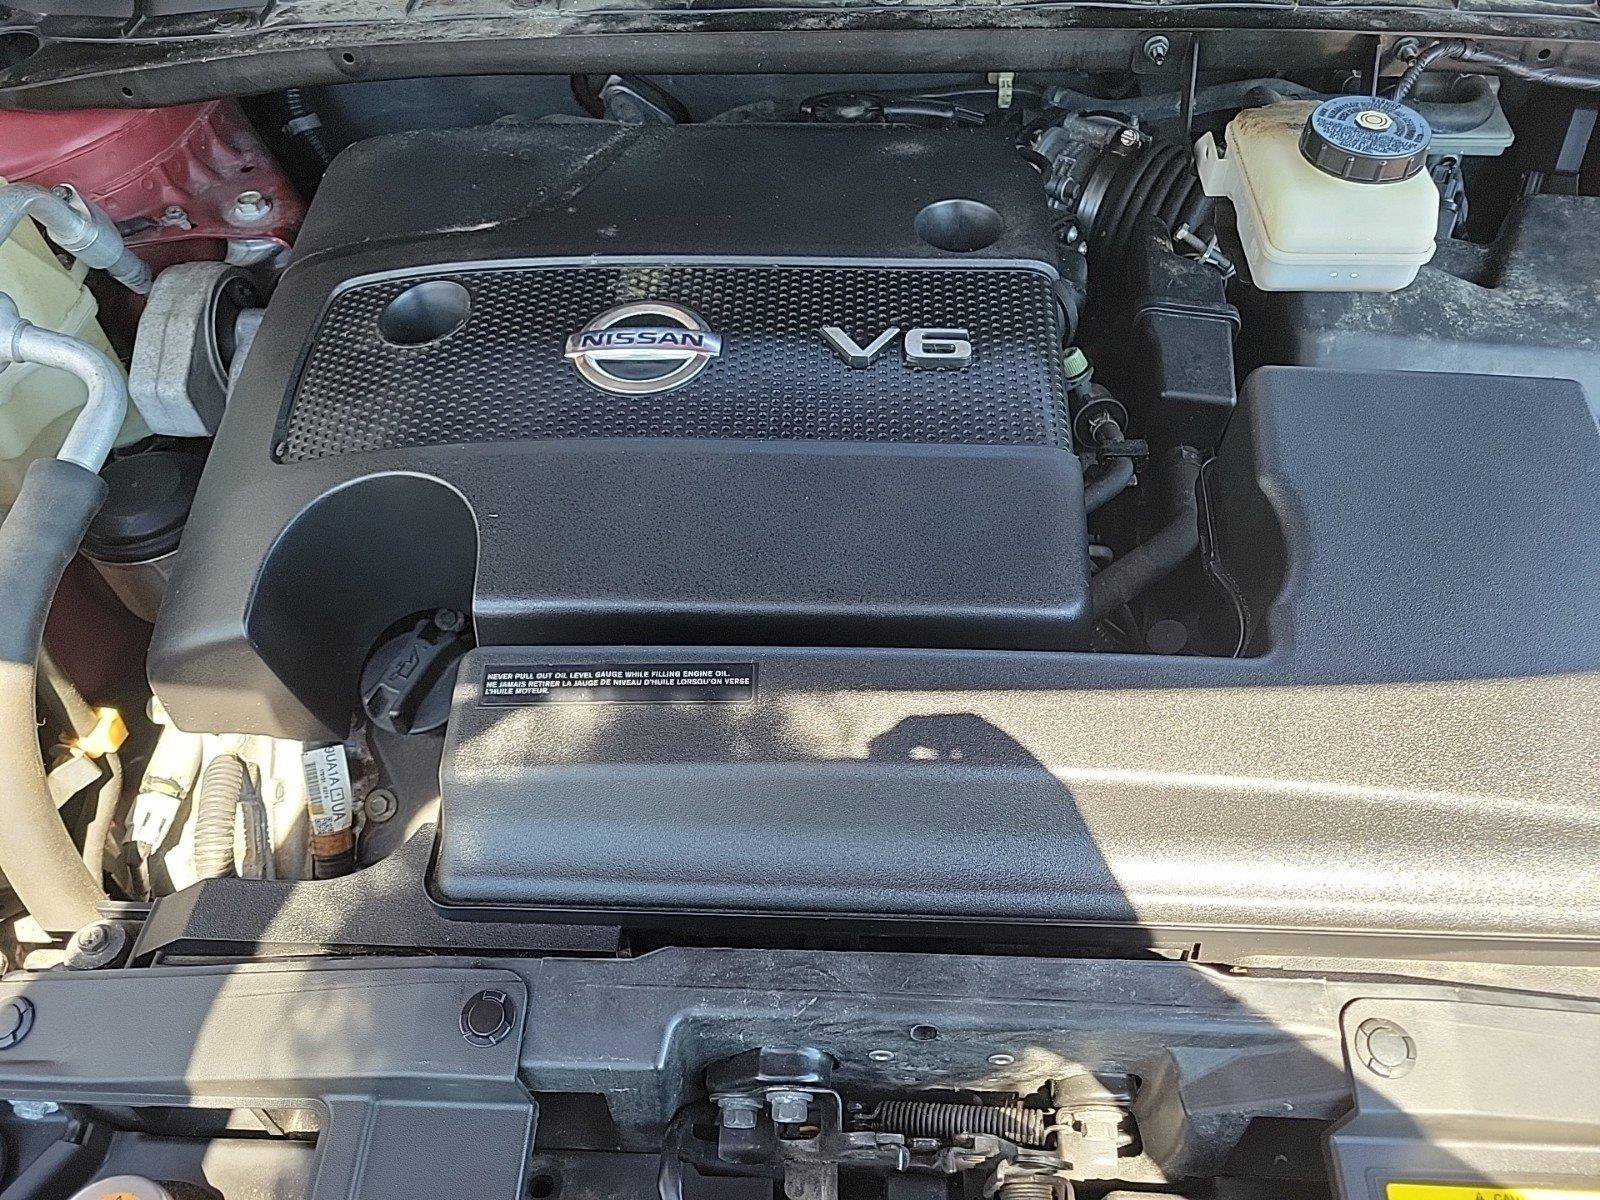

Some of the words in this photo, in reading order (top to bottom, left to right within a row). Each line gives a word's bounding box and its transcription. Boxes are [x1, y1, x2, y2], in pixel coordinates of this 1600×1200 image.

[581, 332, 704, 347] NISSAN
[820, 326, 974, 368] V6
[514, 672, 534, 680] PULL
[569, 671, 593, 679] LEVEL
[651, 670, 680, 678] FILLING
